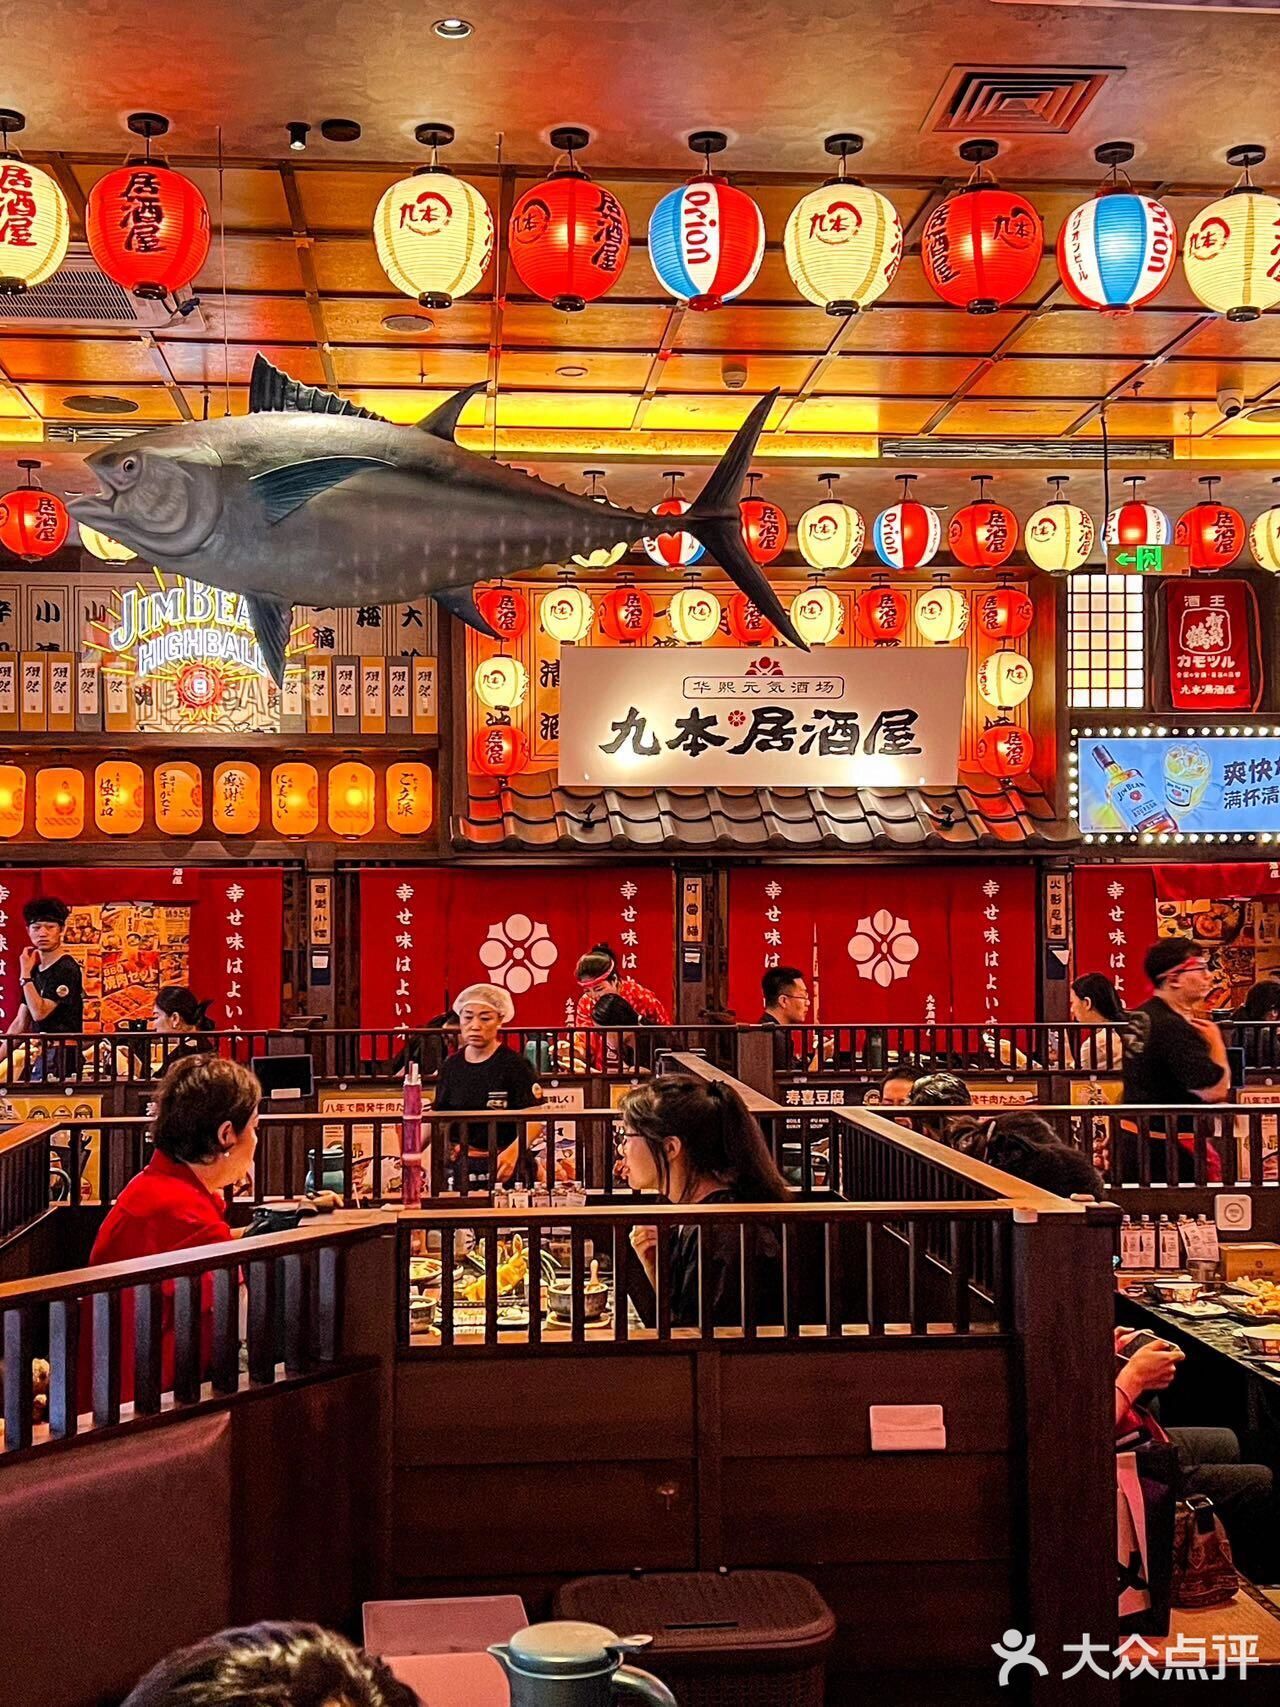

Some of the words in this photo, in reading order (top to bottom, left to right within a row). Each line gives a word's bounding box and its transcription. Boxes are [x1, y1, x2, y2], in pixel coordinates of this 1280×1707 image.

[0, 165, 36, 246] 居酒屋
[121, 172, 166, 253] 居酒屋
[590, 190, 623, 272] 居酒屋
[686, 190, 712, 266] Orion
[1146, 201, 1174, 274] Orion
[757, 507, 782, 549] 居酒屋
[882, 512, 899, 555] Orion
[985, 510, 1008, 553] 居酒屋
[1211, 511, 1236, 554] 居酒屋
[110, 589, 185, 652] JIM
[184, 576, 256, 634] BEA
[879, 593, 898, 630] 居酒屋
[1184, 596, 1225, 607] 酒王
[138, 628, 269, 678] HIGHBALL
[1177, 655, 1236, 668] カモツル
[599, 705, 923, 758] 九本居酒屋
[1223, 756, 1280, 787] 爽快
[1224, 785, 1280, 810] 满杯清
[620, 881, 639, 980] 幸せ味は
[1107, 881, 1128, 1008] 幸せ味はよ
[225, 884, 245, 1041] 幸せ味はよい
[395, 883, 415, 1040] 幸せ味はよい
[786, 1090, 845, 1105] 寿喜豆腐
